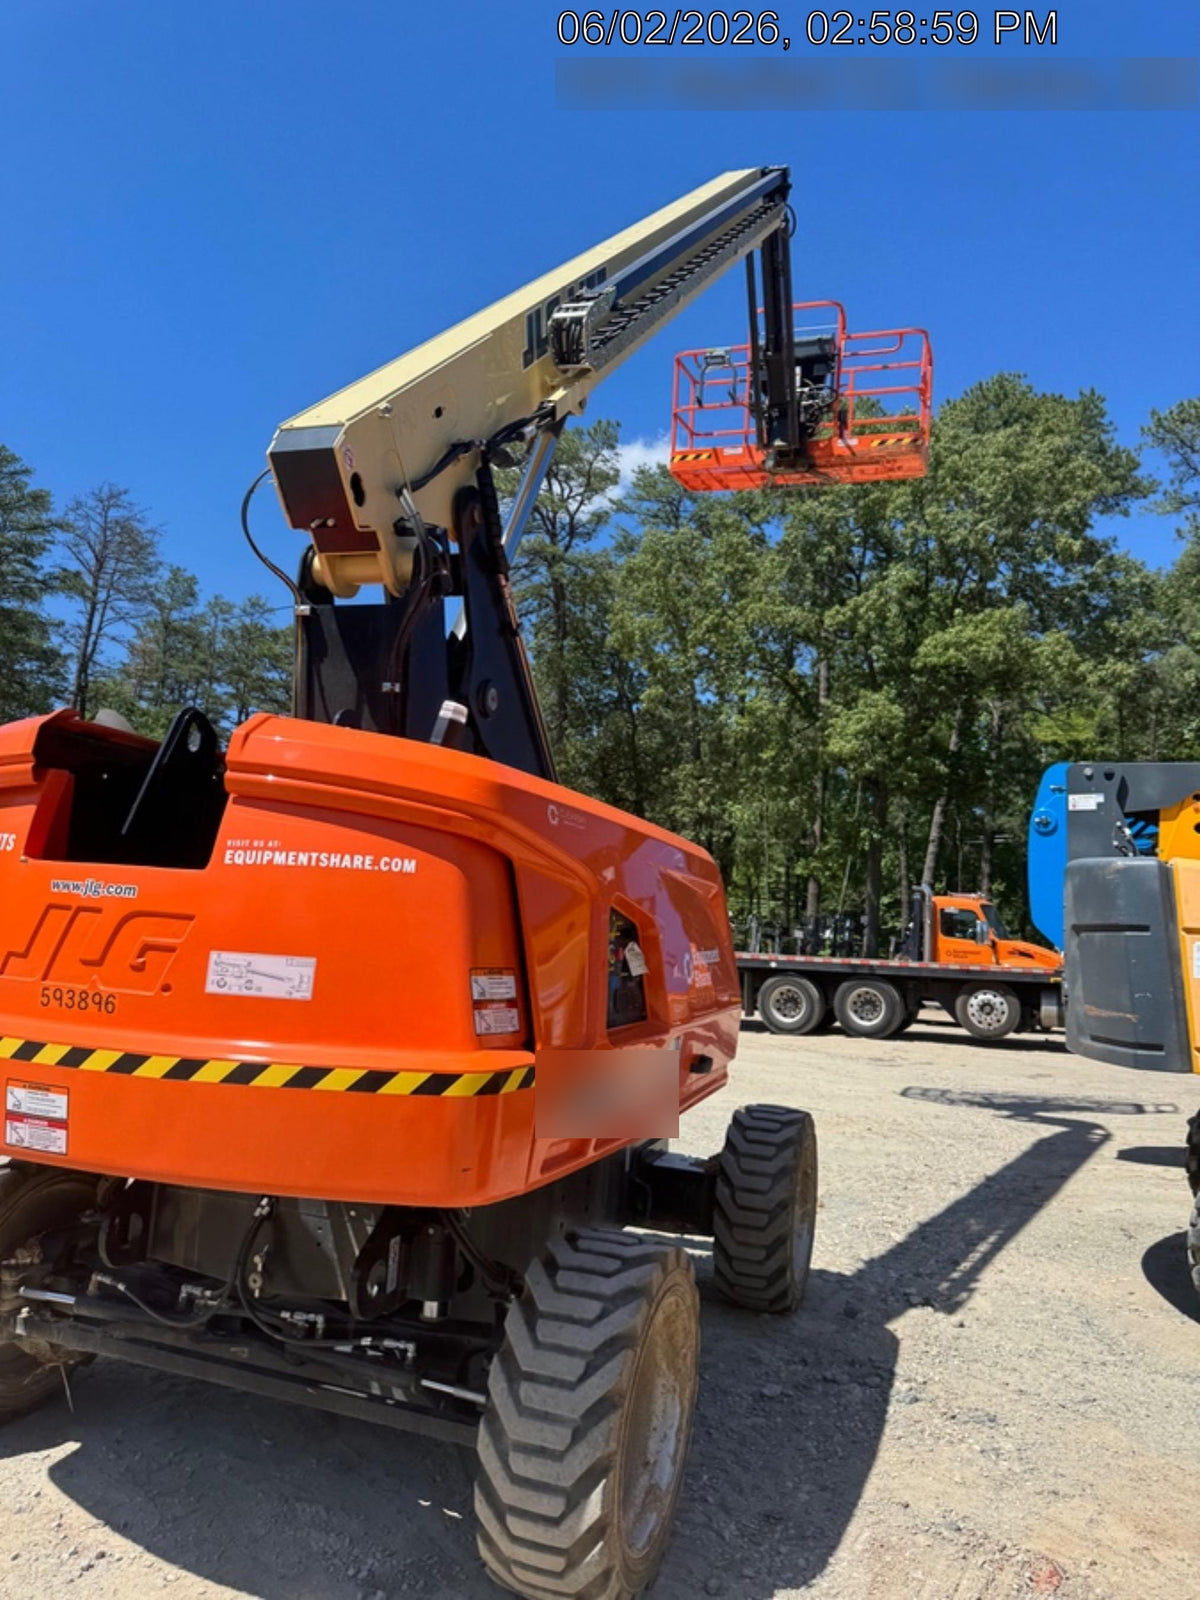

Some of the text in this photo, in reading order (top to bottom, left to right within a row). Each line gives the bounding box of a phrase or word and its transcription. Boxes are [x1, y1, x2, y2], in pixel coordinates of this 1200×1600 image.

[223, 850, 417, 874] EQUIPMENTSHARE.COM
[51, 879, 138, 898] www.jlg.com
[0, 903, 196, 996] JLG
[40, 986, 117, 1014] 593896
